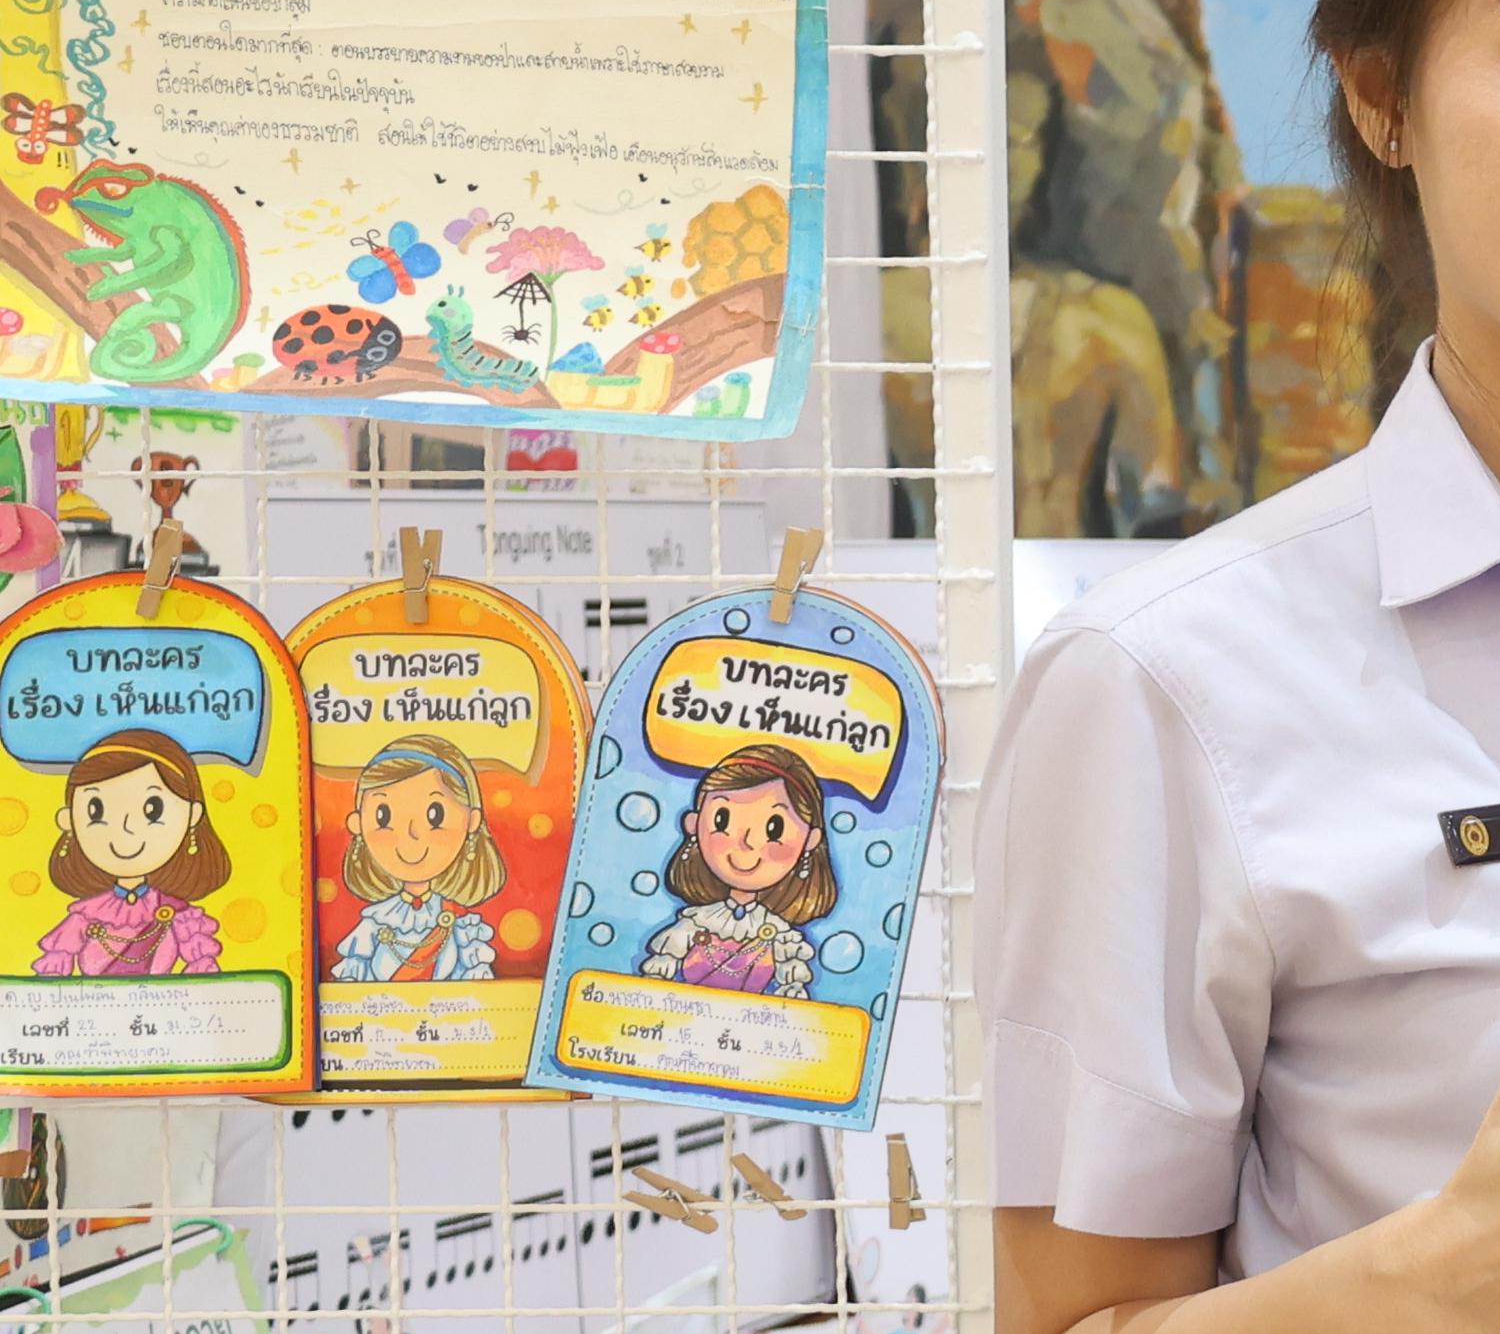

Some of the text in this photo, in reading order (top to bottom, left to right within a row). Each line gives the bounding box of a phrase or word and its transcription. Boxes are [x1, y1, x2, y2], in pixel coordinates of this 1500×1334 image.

[66, 644, 204, 674] บทละคร
[355, 651, 481, 680] บทละคร
[722, 655, 849, 697] บทละคร
[7, 679, 256, 721] เรื่อง เห็นแก่ลูก
[382, 686, 532, 728] เห็นแก่ลูก
[655, 678, 892, 754] เรื่อง เห็นแก่ลูก
[22, 1016, 70, 1038] เลขที่
[129, 1014, 158, 1037] ชั้น
[323, 1022, 364, 1044] เลขที่
[415, 1020, 440, 1042] ชั้น
[620, 1020, 664, 1043] เลขที่
[717, 1029, 742, 1052] ชั้น
[568, 1034, 637, 1067] โรงเรียน
